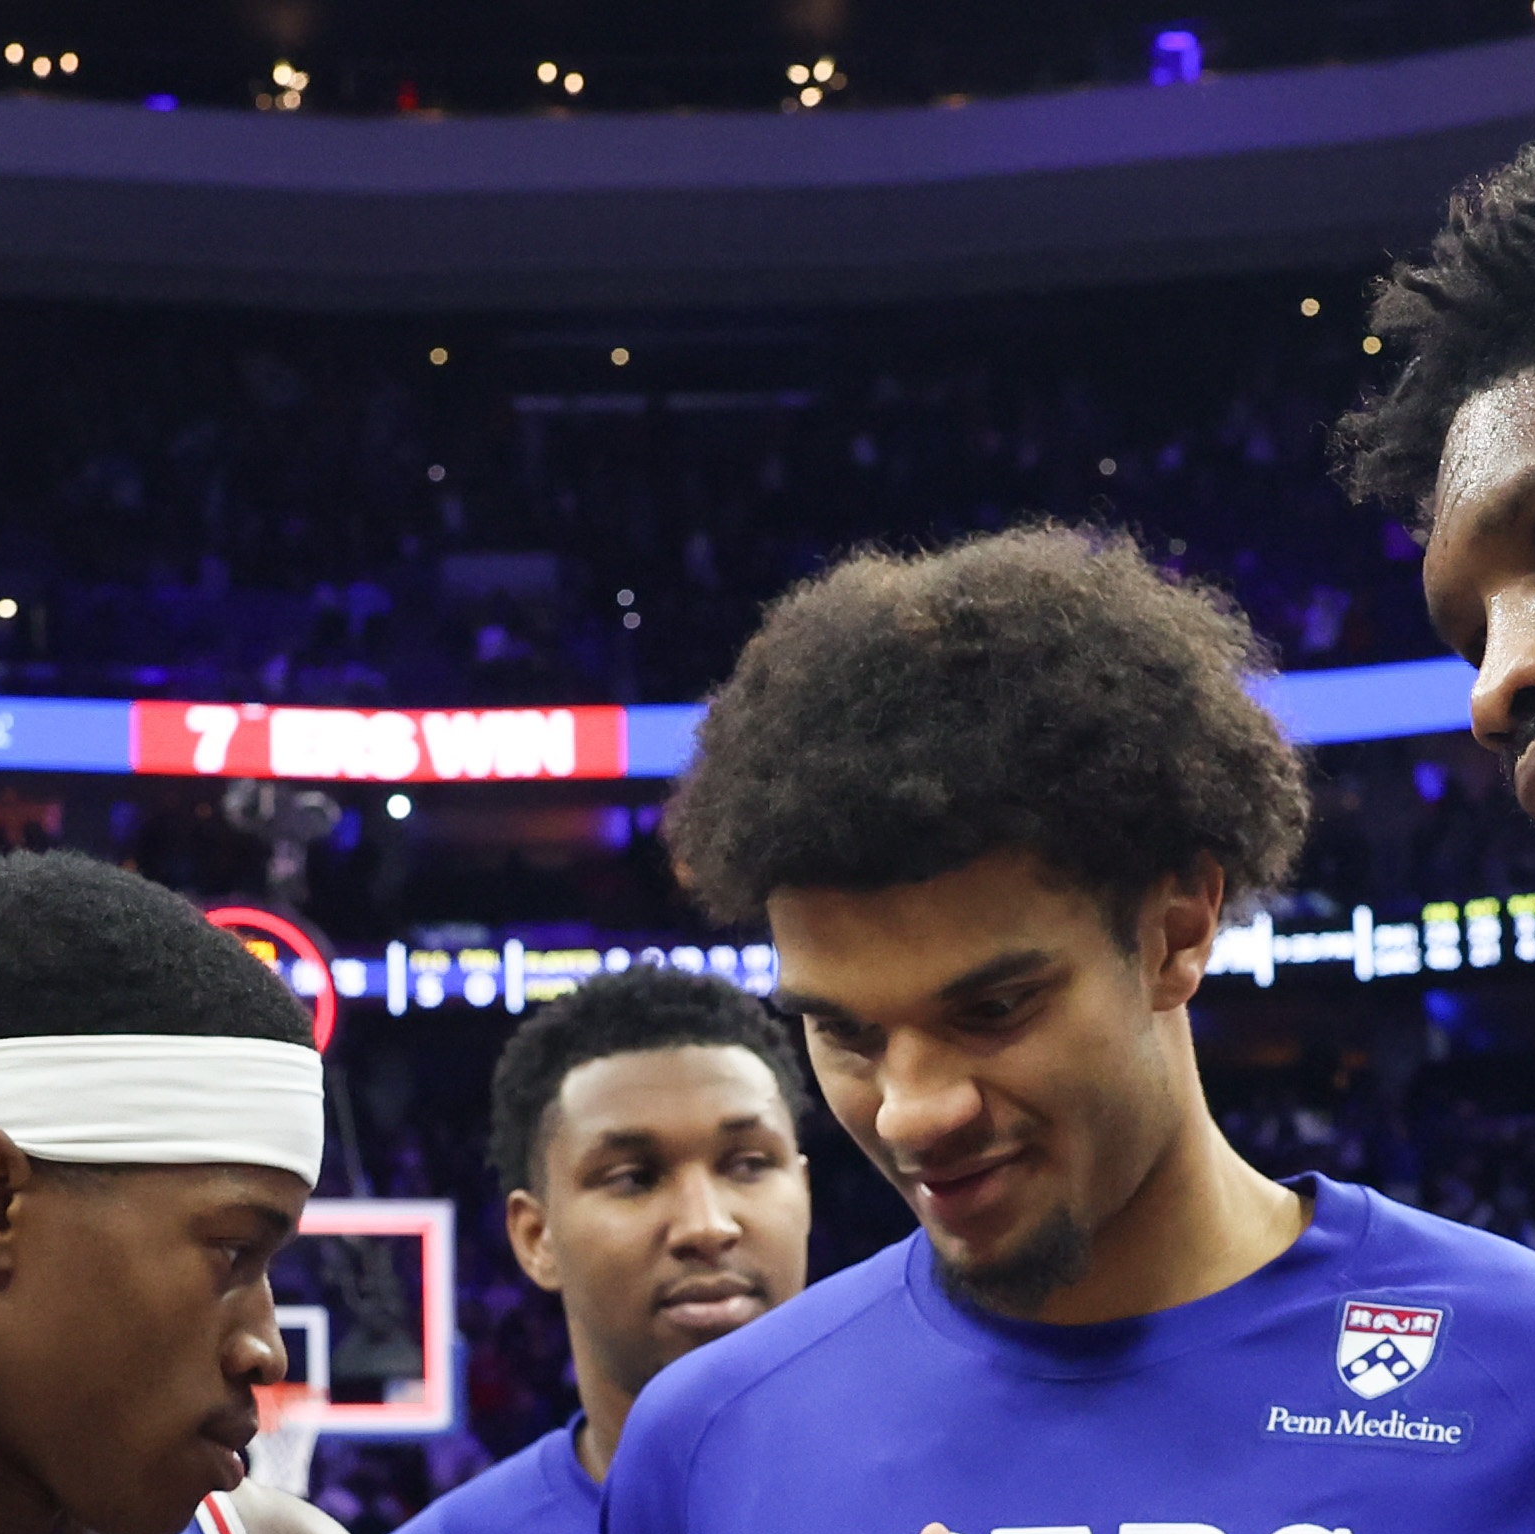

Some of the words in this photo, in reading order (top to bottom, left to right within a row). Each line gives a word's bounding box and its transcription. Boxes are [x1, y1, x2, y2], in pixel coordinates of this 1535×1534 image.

[420, 709, 576, 780] WIN
[1266, 1406, 1332, 1435] Penn
[1334, 1409, 1462, 1444] Medicine
